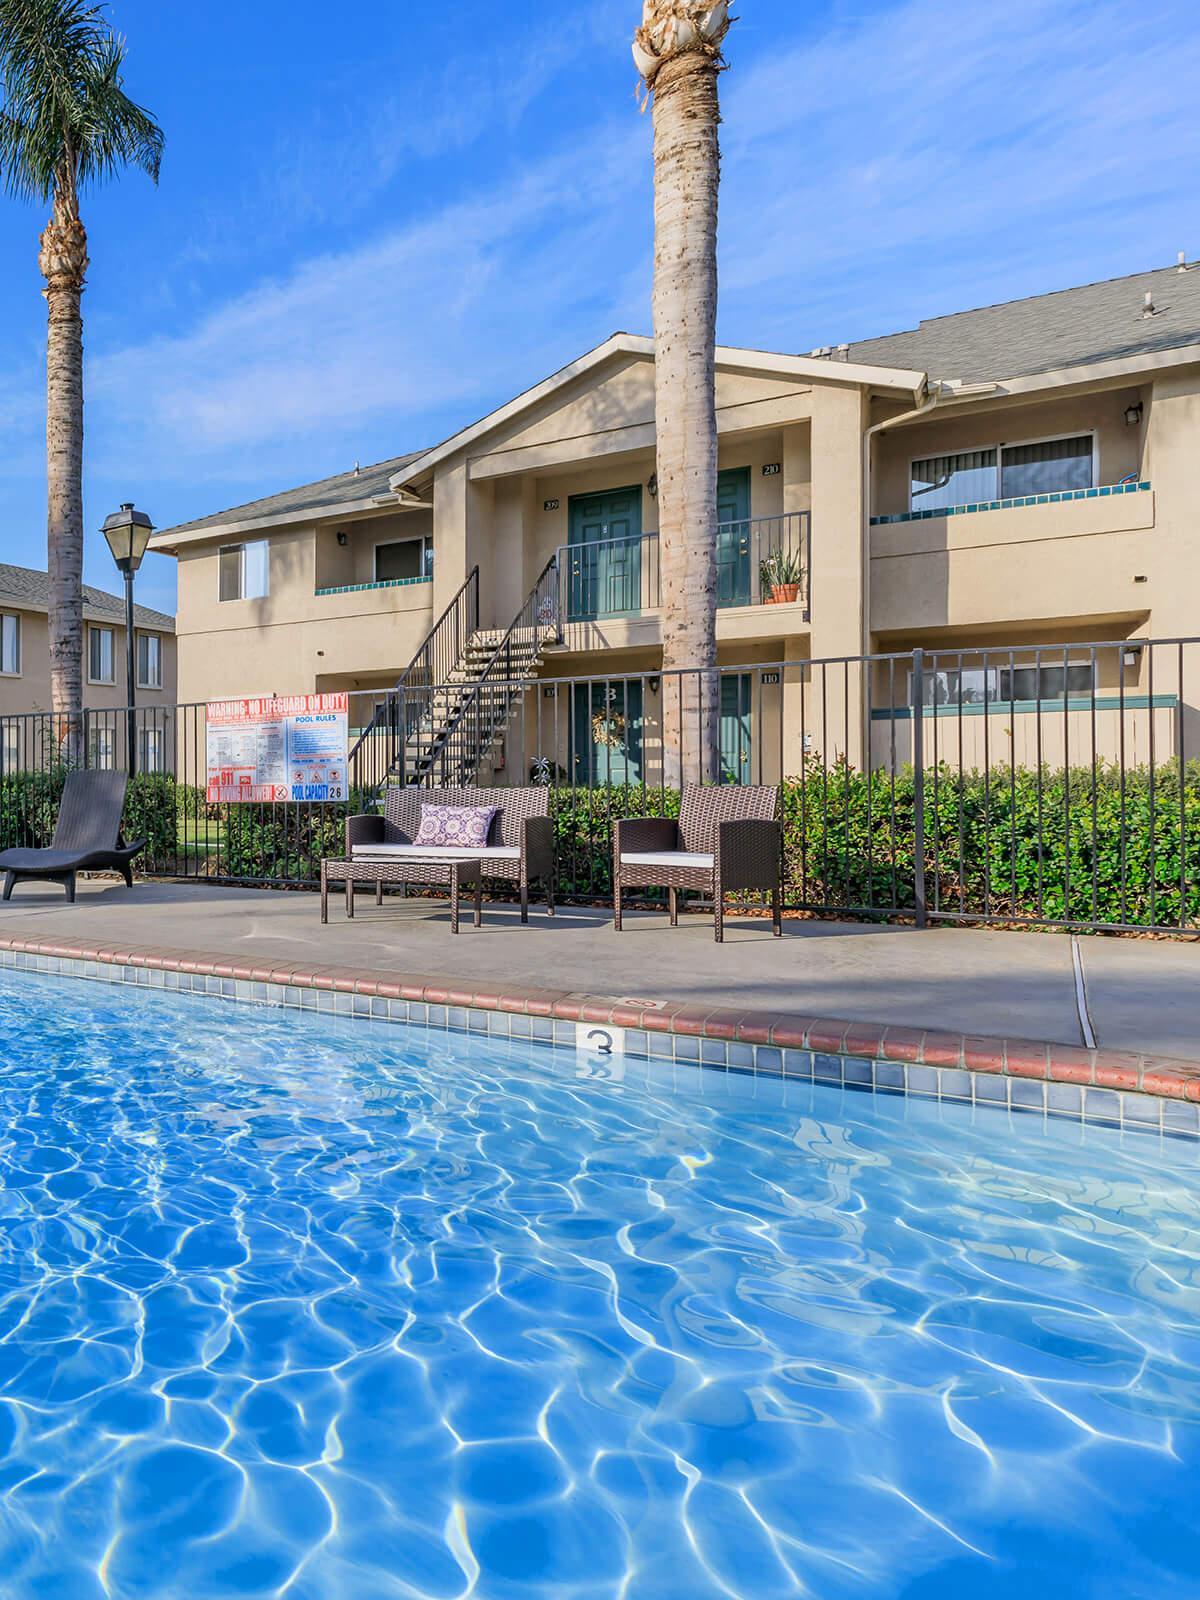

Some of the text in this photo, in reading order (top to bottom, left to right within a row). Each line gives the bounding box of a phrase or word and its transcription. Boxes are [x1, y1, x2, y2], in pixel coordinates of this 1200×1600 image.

[764, 464, 779, 475] 210
[763, 674, 778, 684] 110
[603, 687, 617, 701] B
[208, 693, 346, 718] WARNING: NO LIFEGUARD ON DUTY
[315, 714, 337, 722] RULES
[221, 771, 234, 785] 911
[292, 784, 304, 800] POOL
[305, 784, 328, 800] CAPACITY
[587, 1029, 613, 1054] 3
